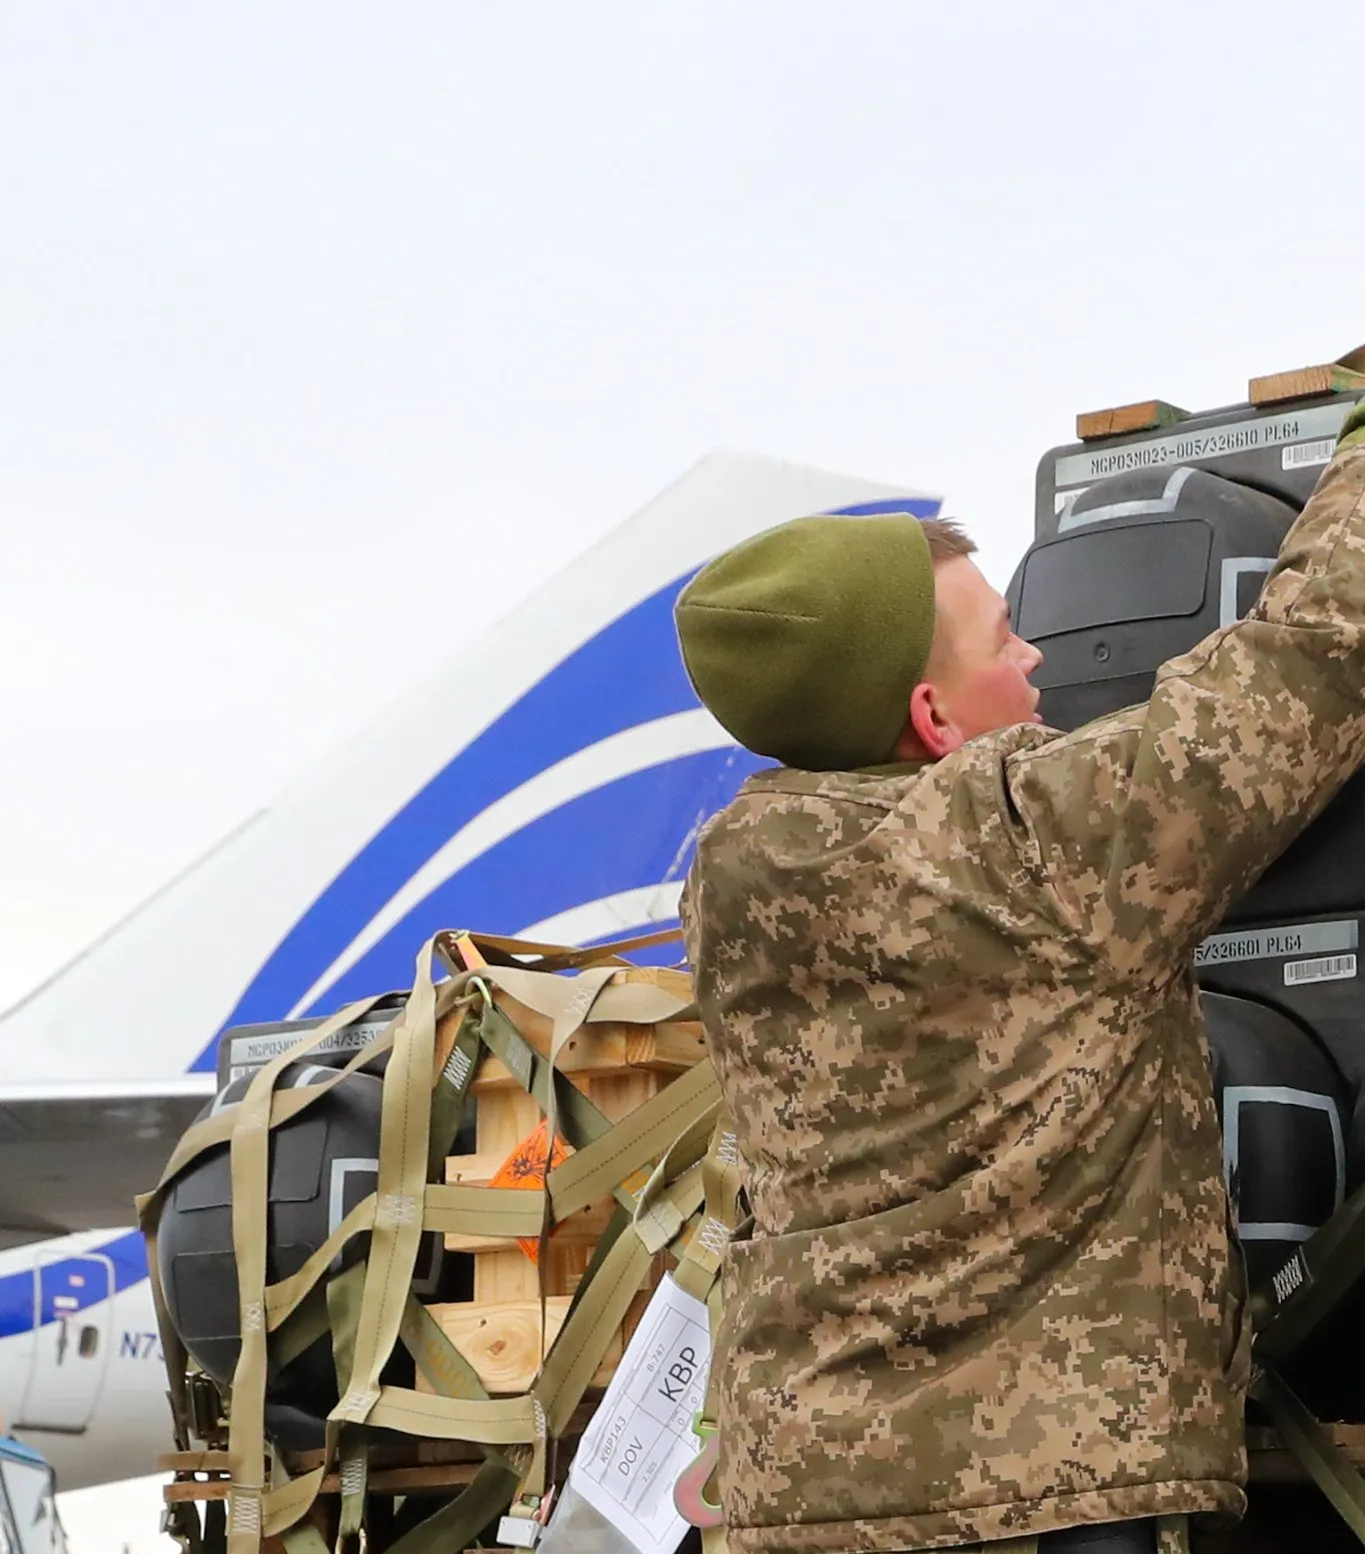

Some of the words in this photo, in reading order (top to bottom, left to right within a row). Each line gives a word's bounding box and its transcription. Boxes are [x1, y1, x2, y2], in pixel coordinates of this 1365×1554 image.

[1264, 421, 1299, 443] PL64
[1267, 934, 1302, 953] PL64
[119, 1332, 163, 1361] N7
[658, 1346, 698, 1403] KBP
[599, 1415, 627, 1464] KBP143
[617, 1436, 643, 1477] DOV
